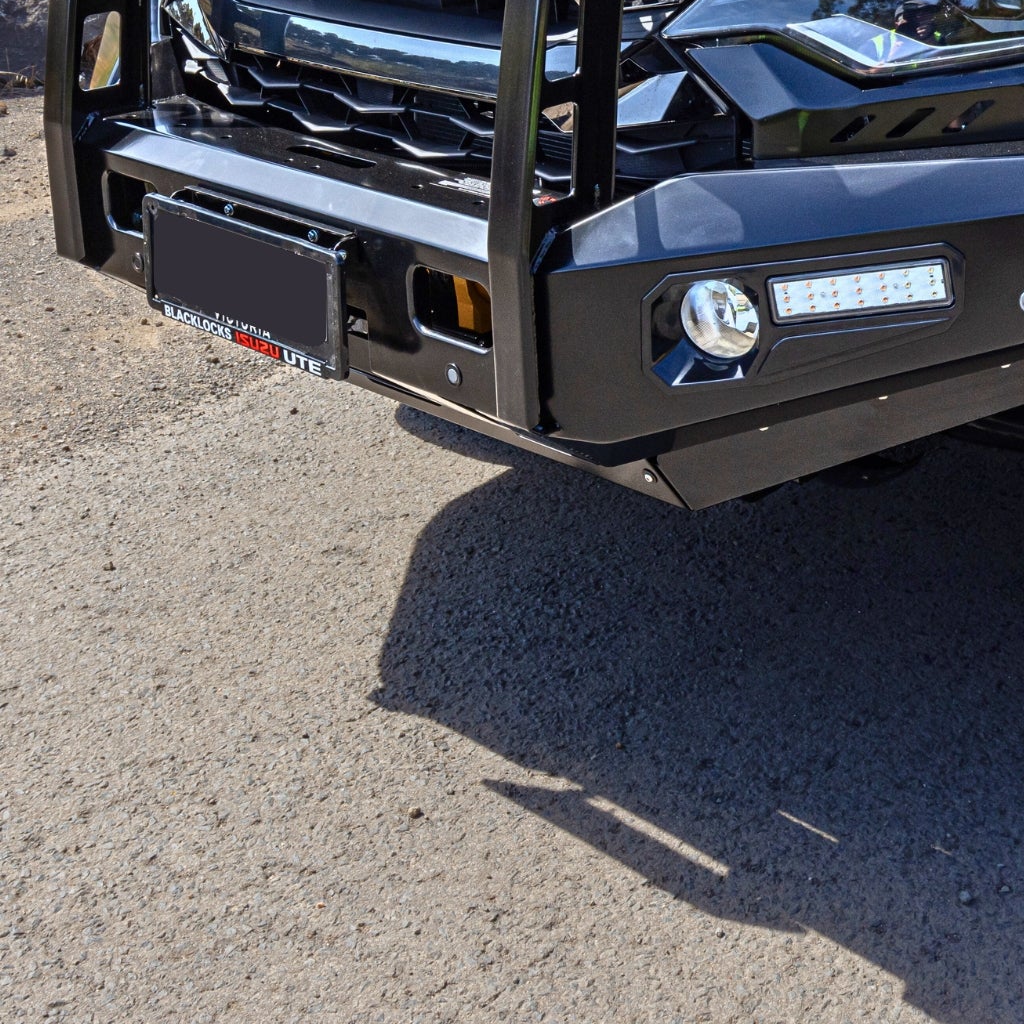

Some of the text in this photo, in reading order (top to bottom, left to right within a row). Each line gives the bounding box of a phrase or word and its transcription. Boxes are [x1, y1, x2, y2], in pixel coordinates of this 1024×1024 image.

[164, 304, 322, 376] BLACKLOCKS ISUZU UTE
